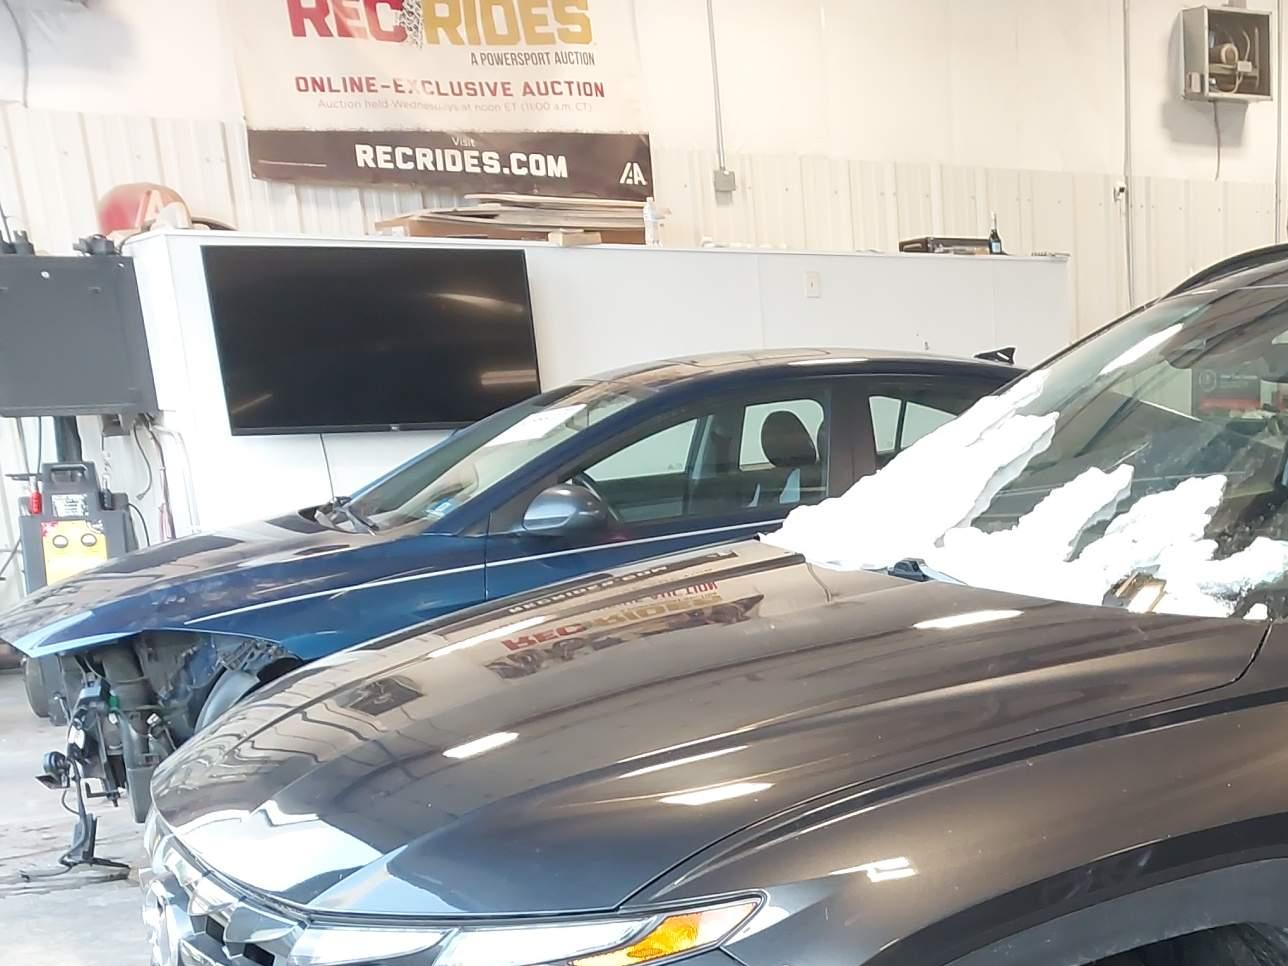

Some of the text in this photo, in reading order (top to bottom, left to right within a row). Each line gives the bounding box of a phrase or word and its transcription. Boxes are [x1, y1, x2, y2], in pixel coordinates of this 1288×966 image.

[287, 0, 593, 46] REC RIDES
[471, 51, 596, 66] A POWERSPORT AUCTION
[521, 80, 606, 98] AUCTION
[451, 136, 476, 147] Visit
[354, 144, 568, 178] RECRIDES.COM
